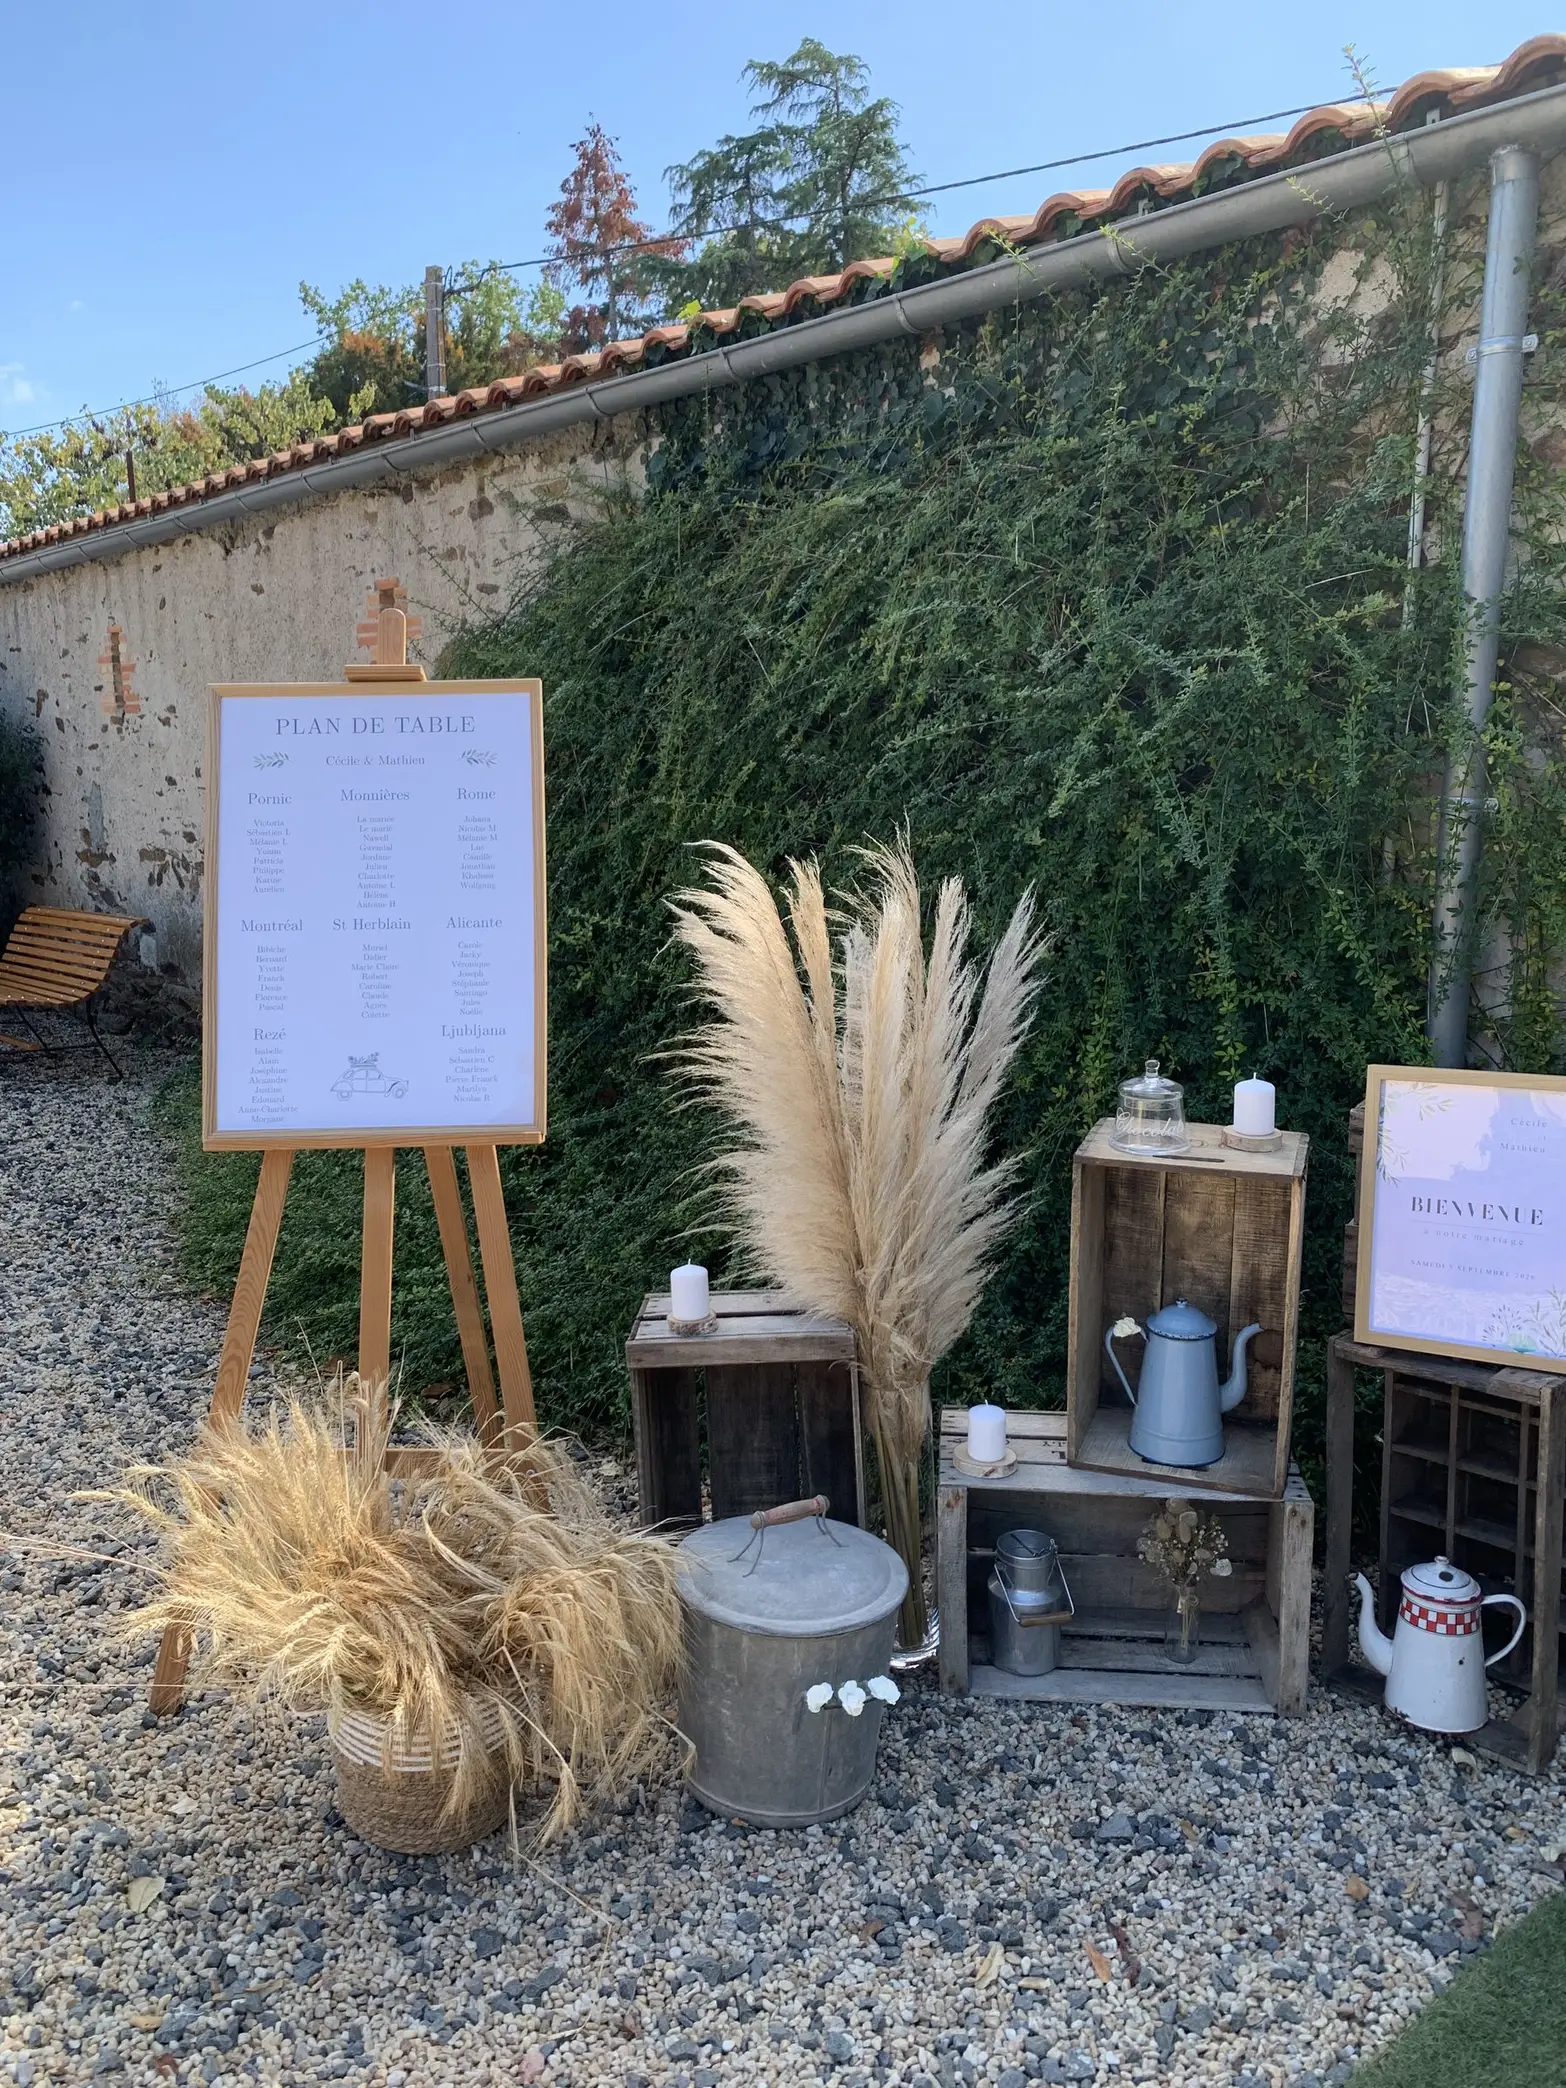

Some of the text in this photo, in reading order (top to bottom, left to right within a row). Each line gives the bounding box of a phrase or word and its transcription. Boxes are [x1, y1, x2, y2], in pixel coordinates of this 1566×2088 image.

[276, 716, 475, 735] PLAN DE TABLE
[326, 755, 425, 766] Cécile & Mathieu
[248, 793, 292, 804] Pornic
[341, 789, 410, 801] Monnières
[457, 788, 496, 799] Rome
[253, 819, 285, 827] Victoria
[253, 867, 284, 875] Philippe
[460, 881, 496, 890] Wolfgang
[241, 919, 303, 931] Montréal
[333, 918, 411, 930] St Herblain
[447, 917, 502, 928] Alicante
[454, 989, 487, 997] Santiago
[259, 1003, 283, 1011] Pascal
[254, 1028, 286, 1040] Rezé
[441, 1024, 506, 1039] Ljubljana
[458, 1046, 485, 1054] Sandra
[1500, 1143, 1545, 1153] Mathieu
[1412, 1197, 1543, 1225] BIENVENUE
[1436, 1230, 1467, 1239] notre
[1474, 1235, 1524, 1246] mariage
[1410, 1260, 1445, 1268] SAMEDI
[1458, 1266, 1510, 1276] SEPTEMBRE
